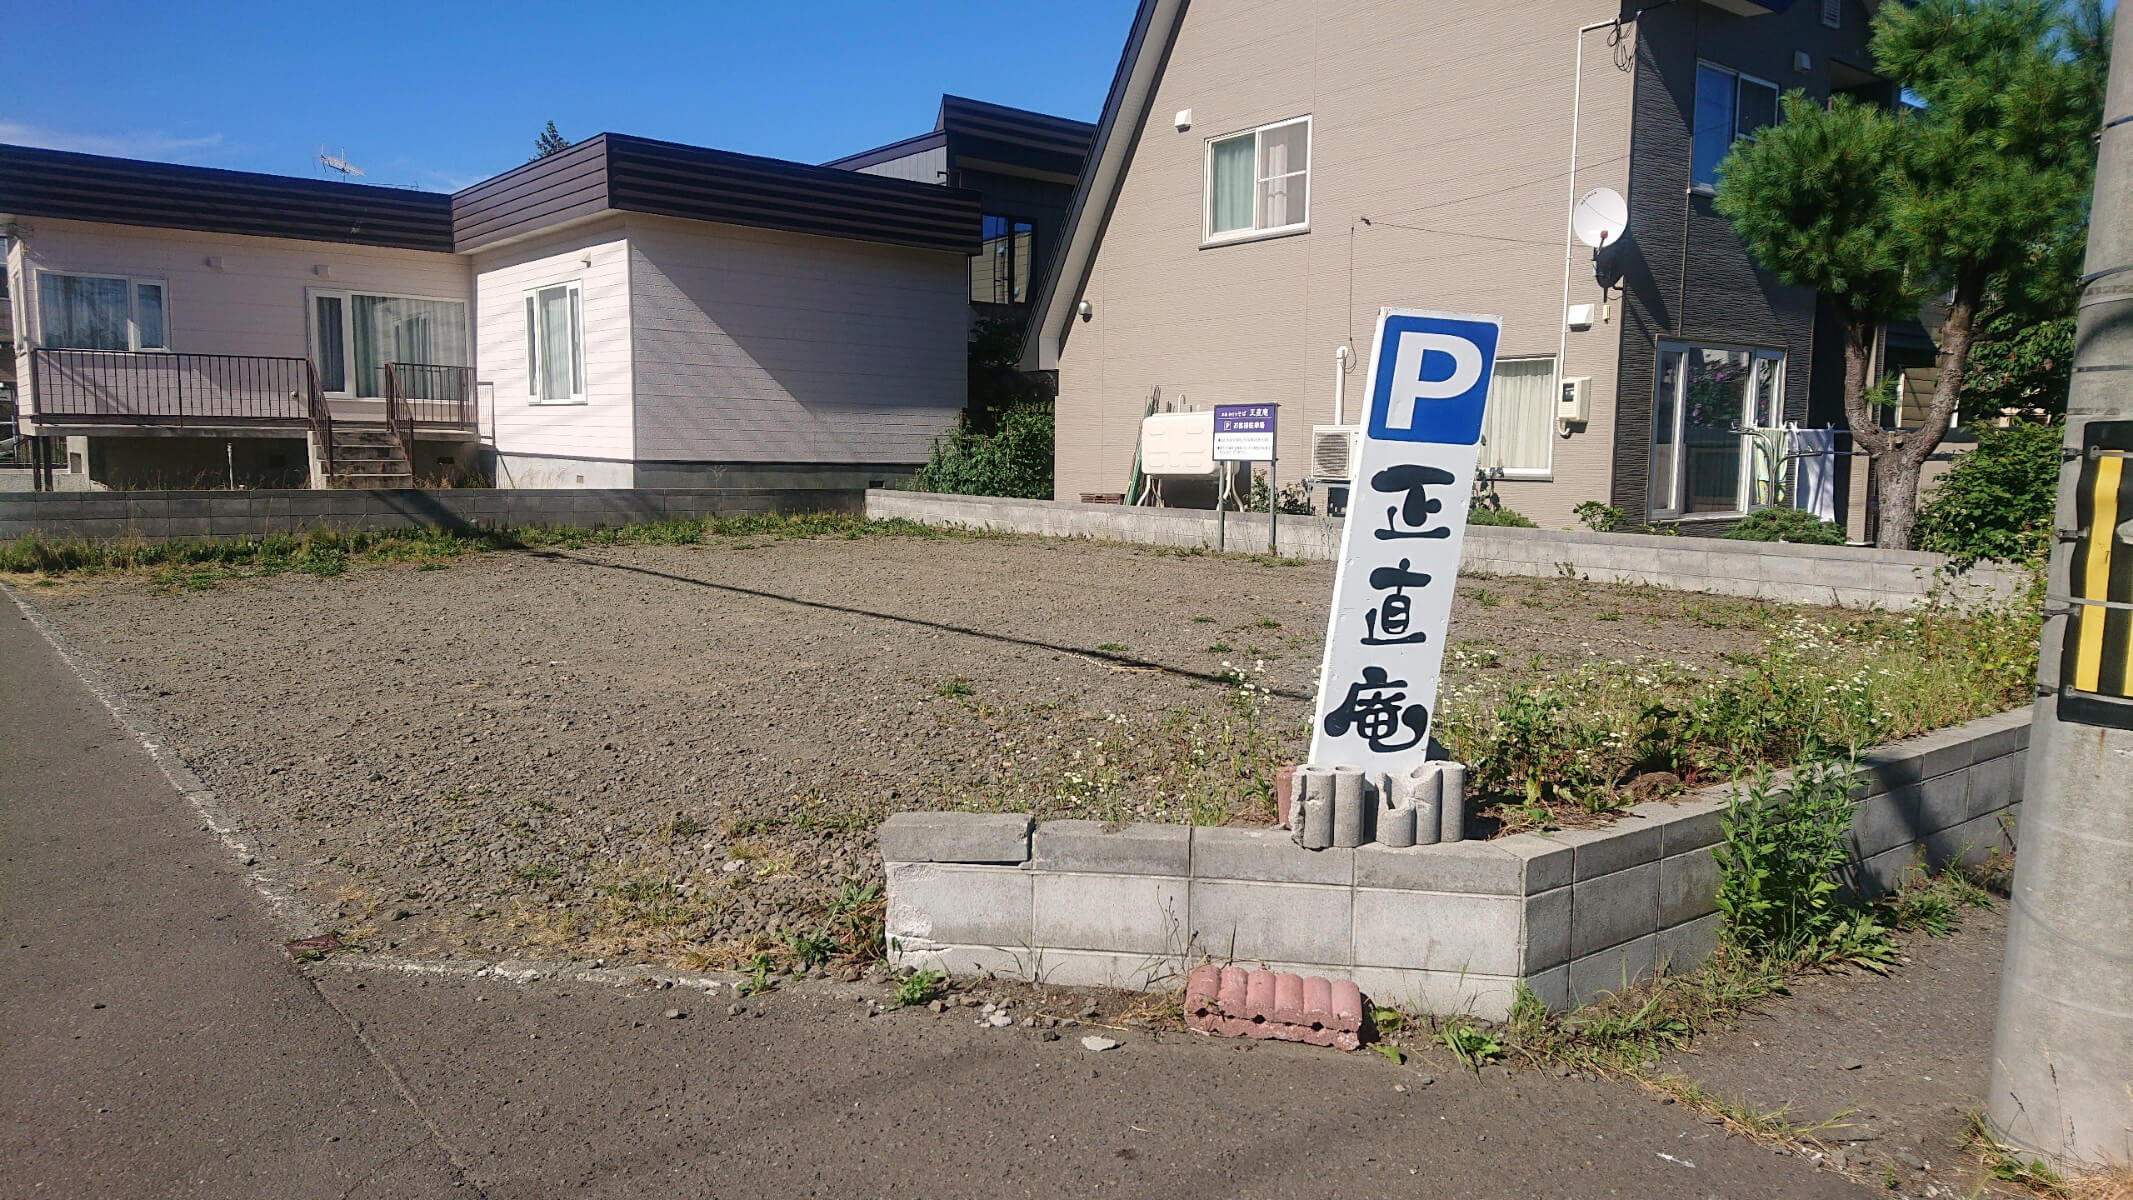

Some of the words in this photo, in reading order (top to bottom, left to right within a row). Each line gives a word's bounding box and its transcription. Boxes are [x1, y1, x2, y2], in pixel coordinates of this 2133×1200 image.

[1385, 331, 1483, 430] P
[1324, 464, 1456, 754] 正直庵
